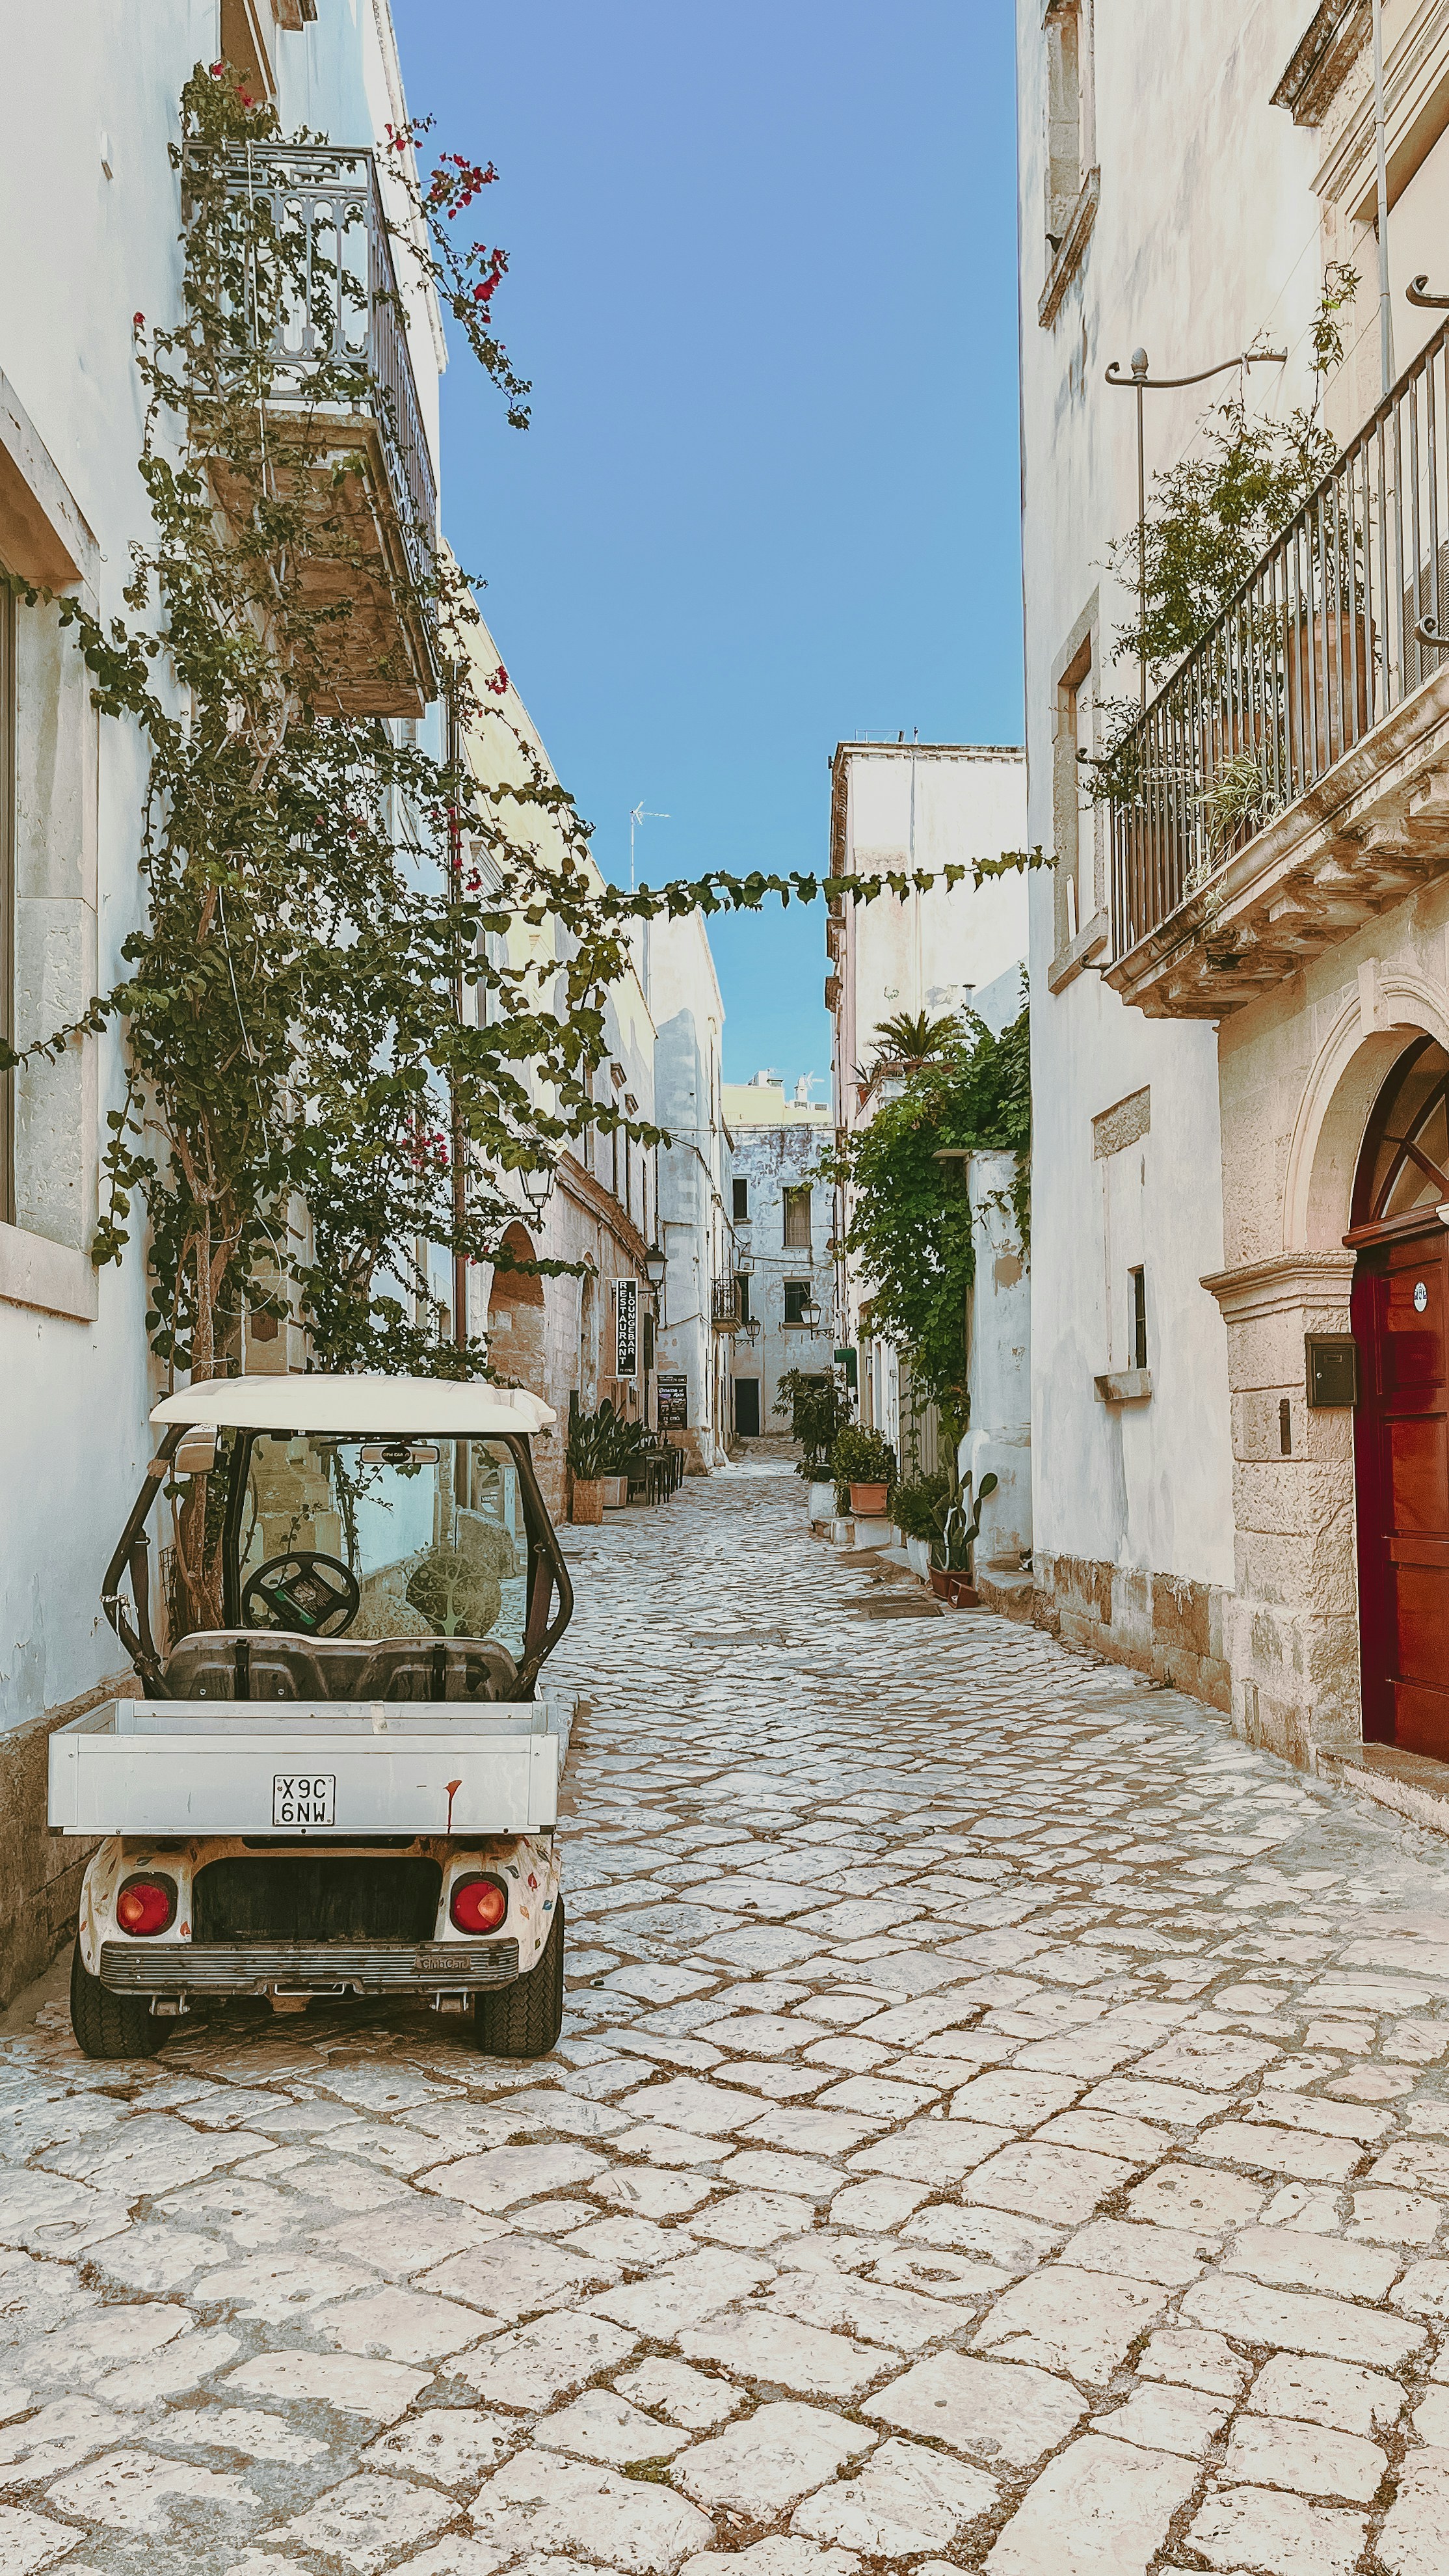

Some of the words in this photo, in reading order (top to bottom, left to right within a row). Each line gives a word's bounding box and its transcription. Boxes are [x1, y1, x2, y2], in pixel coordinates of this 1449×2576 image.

[618, 1281, 627, 1365] RESTAURANT
[282, 1778, 326, 1799] X9C
[282, 1802, 325, 1822] 6NW
